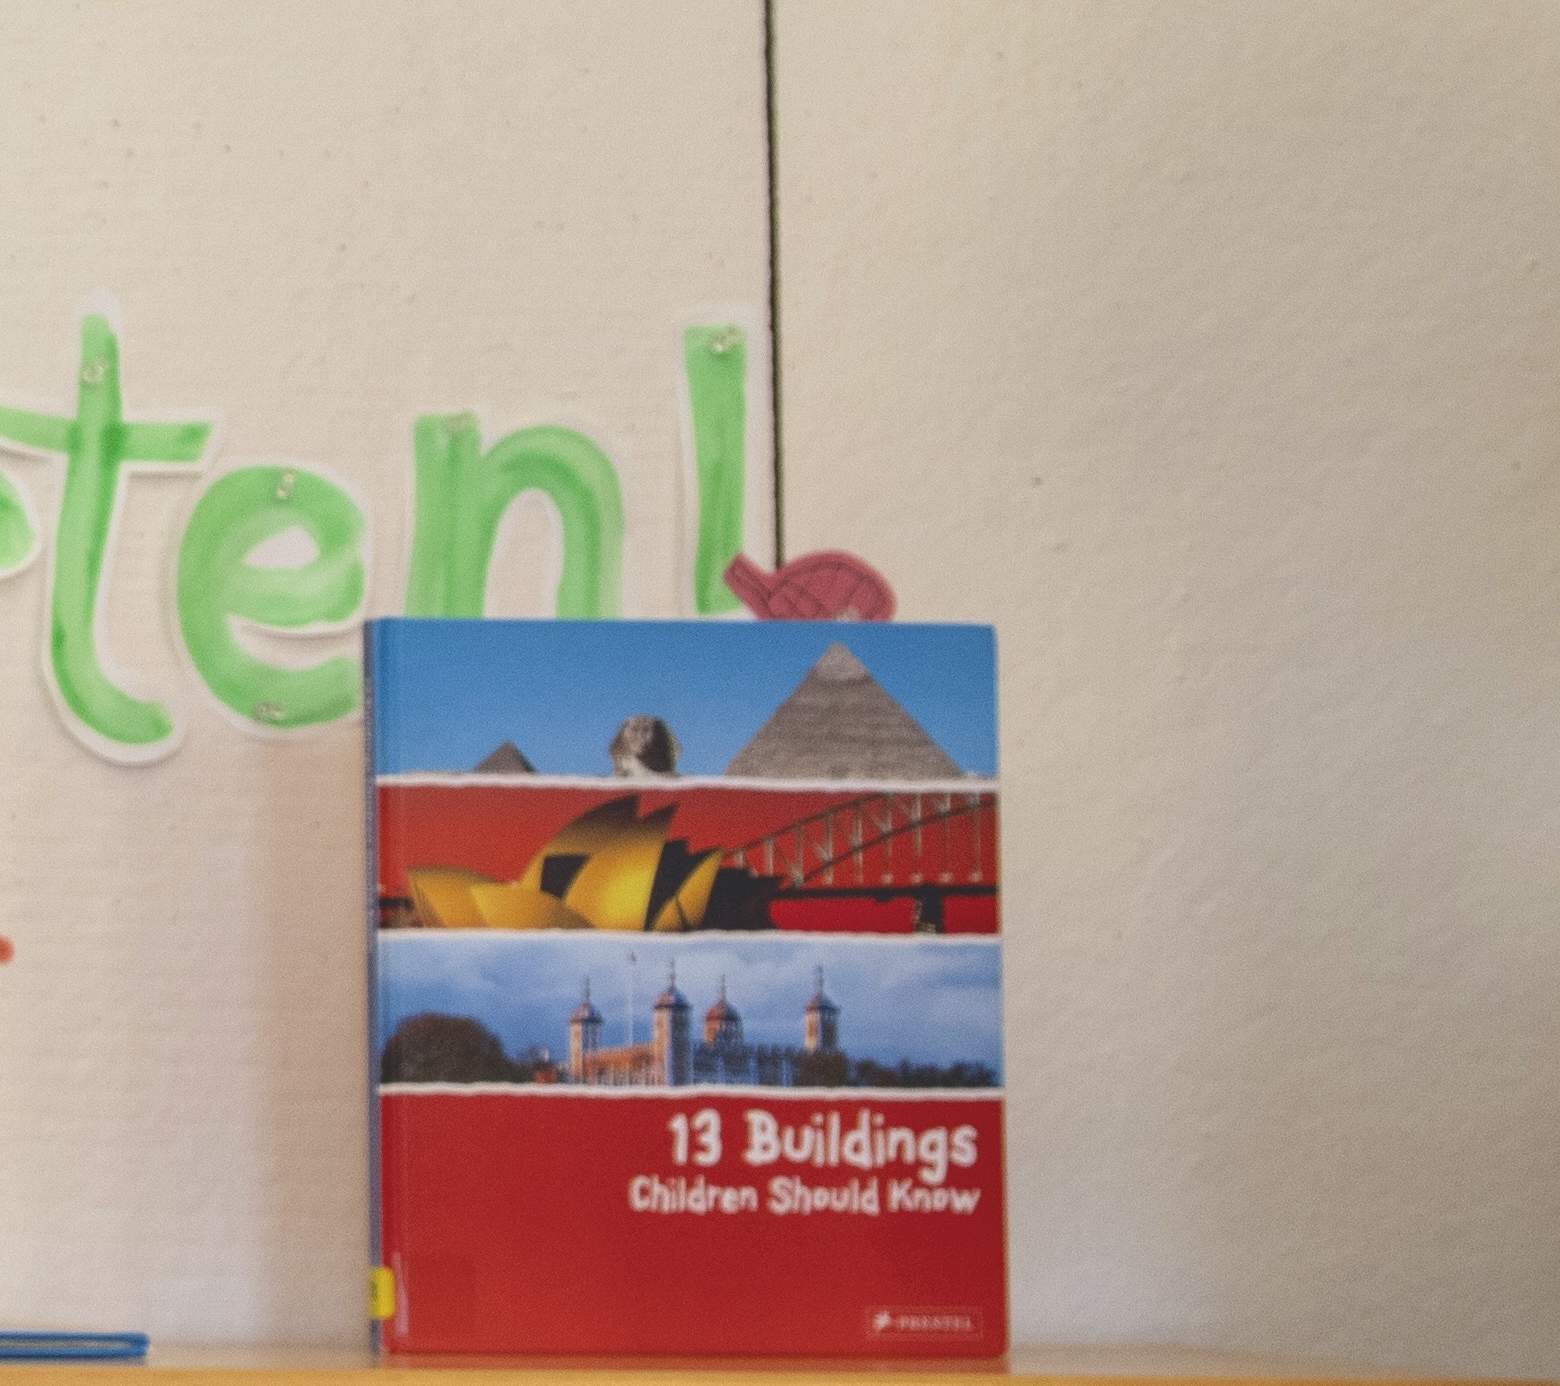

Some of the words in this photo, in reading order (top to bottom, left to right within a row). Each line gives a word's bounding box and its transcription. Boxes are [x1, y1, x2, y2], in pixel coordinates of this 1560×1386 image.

[668, 1108, 722, 1167] 13
[743, 1108, 978, 1186] Buildings
[628, 1174, 759, 1215] Children
[768, 1175, 880, 1216] Should
[887, 1177, 982, 1215] Know
